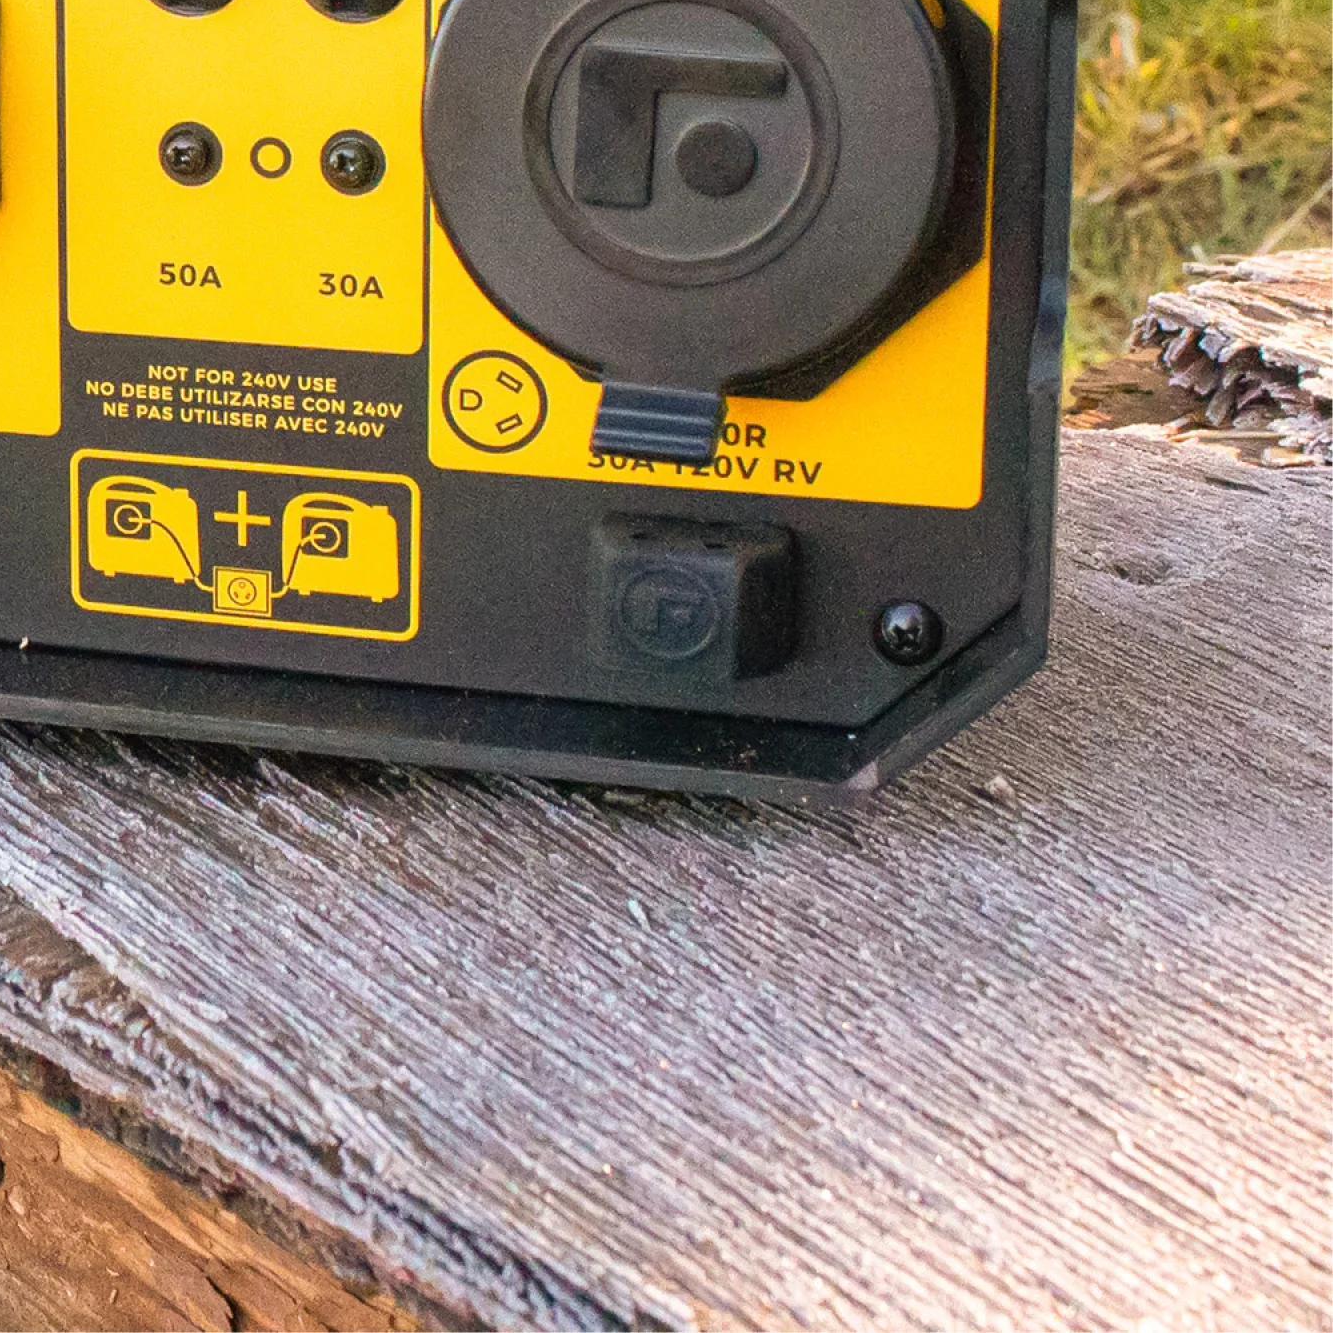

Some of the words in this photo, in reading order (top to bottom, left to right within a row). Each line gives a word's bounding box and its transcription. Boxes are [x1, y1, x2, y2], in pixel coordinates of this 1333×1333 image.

[160, 263, 222, 288] 50A
[319, 273, 384, 299] 30A
[148, 365, 188, 382] NOT
[195, 368, 235, 386] FOR
[242, 371, 291, 391] 240V
[298, 376, 338, 394] USE
[86, 380, 115, 397] NO
[121, 382, 174, 402] DEBE
[180, 387, 295, 411] UTILIZARSE
[302, 396, 346, 415] CON
[353, 401, 404, 420] 240V
[103, 401, 129, 418] NE
[136, 404, 174, 422] PAS
[180, 408, 267, 430] UTILISER
[274, 415, 328, 434] AVEC
[335, 419, 386, 439] 240V
[774, 459, 823, 485] RV
